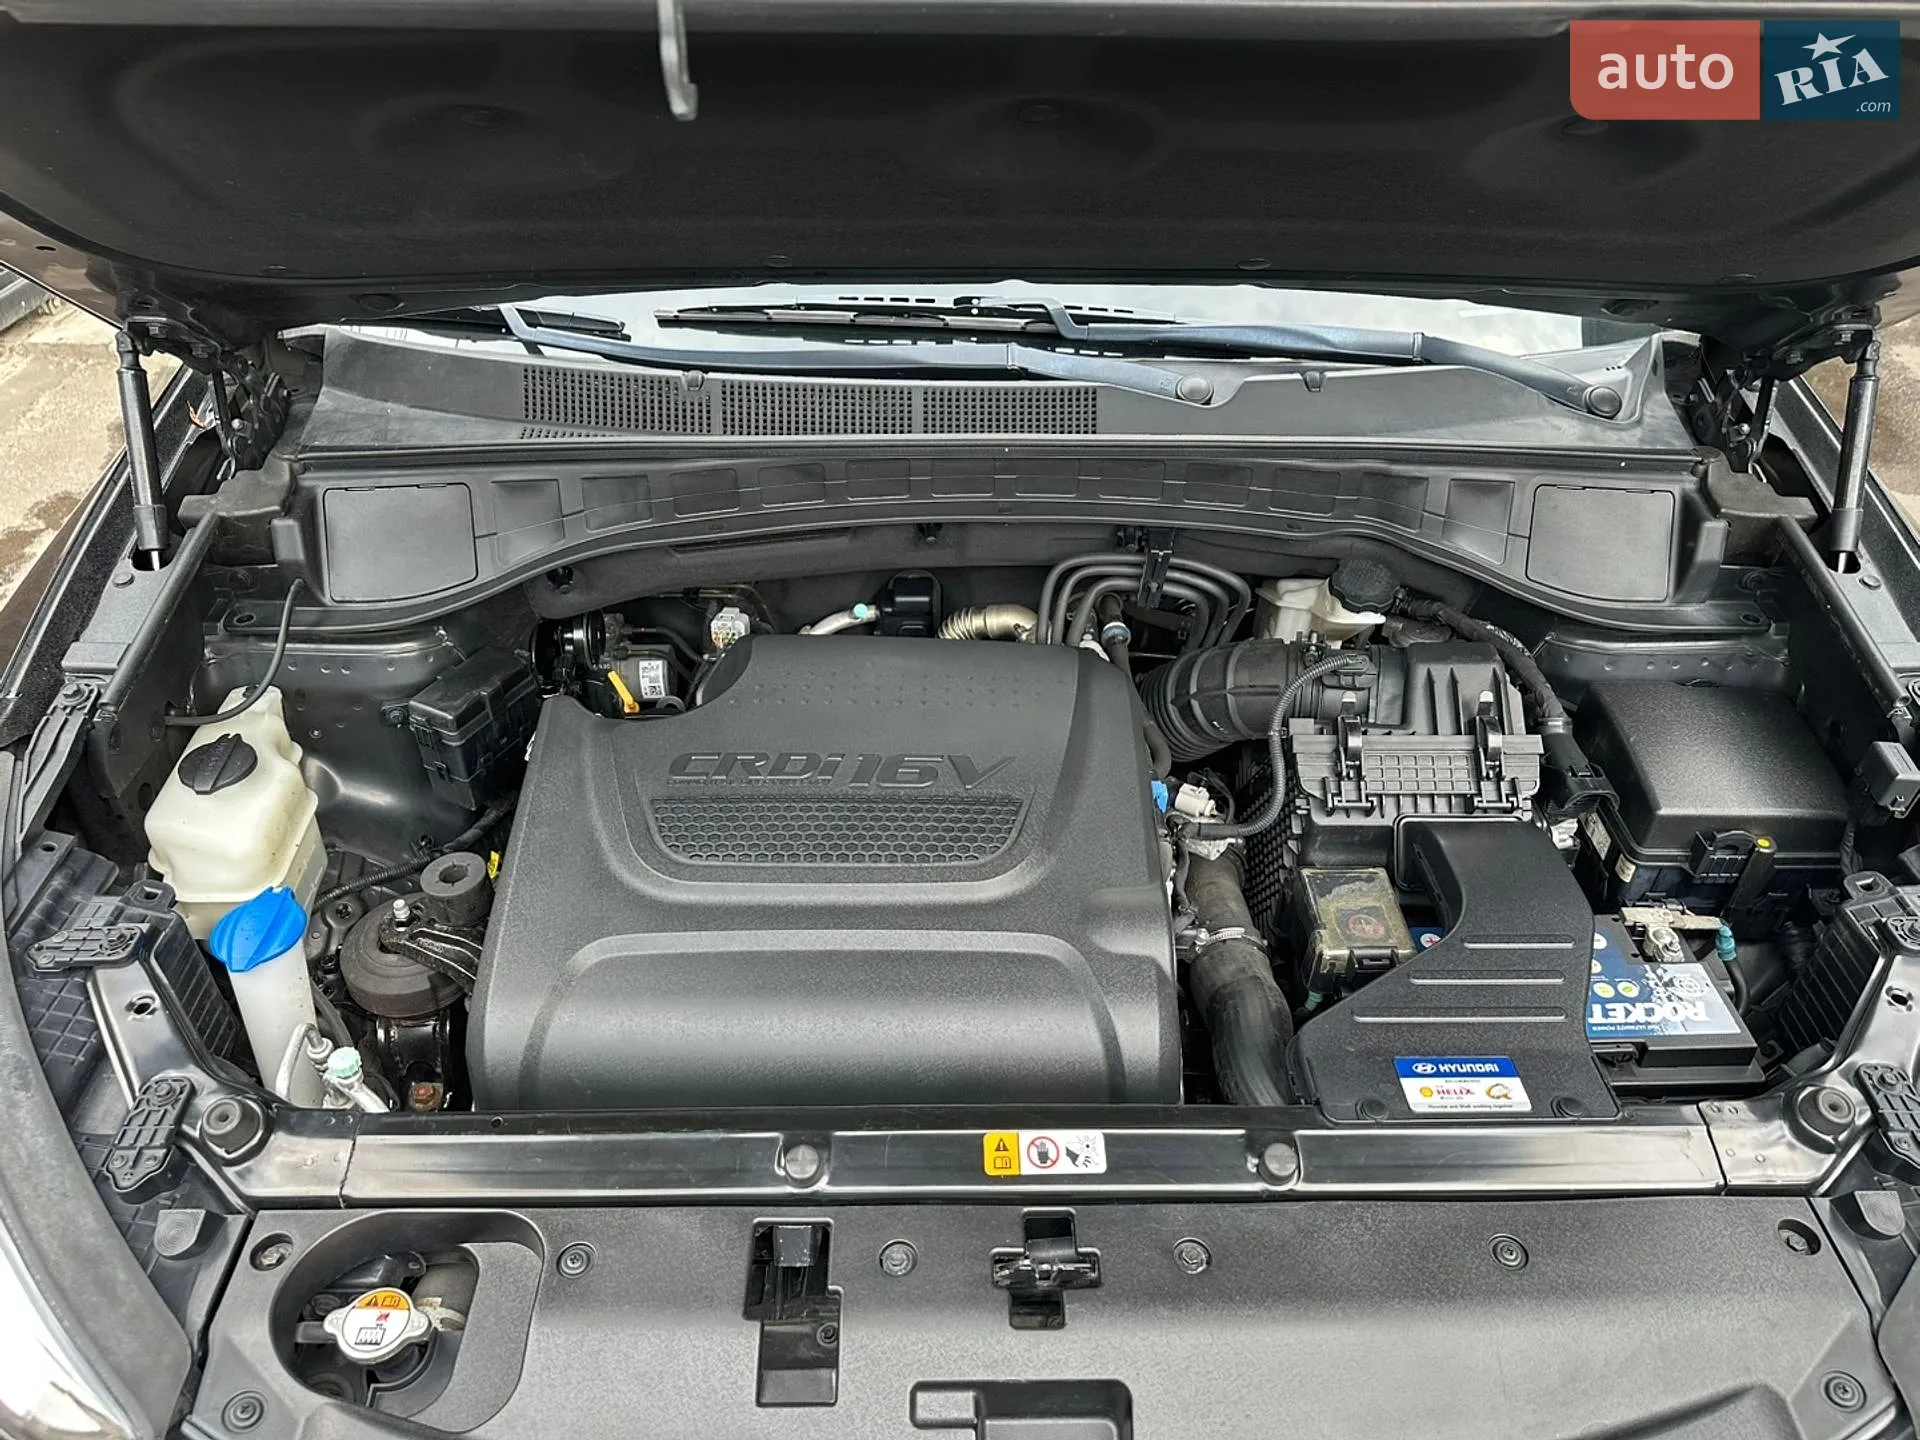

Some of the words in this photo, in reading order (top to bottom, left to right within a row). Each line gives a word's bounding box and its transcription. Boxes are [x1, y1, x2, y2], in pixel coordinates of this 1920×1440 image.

[668, 752, 846, 780] CRDi
[849, 753, 1016, 790] 16V
[1588, 1001, 1712, 1024] ROCKET
[1439, 1063, 1499, 1073] HYUNDAI
[1436, 1087, 1474, 1096] HELIX
